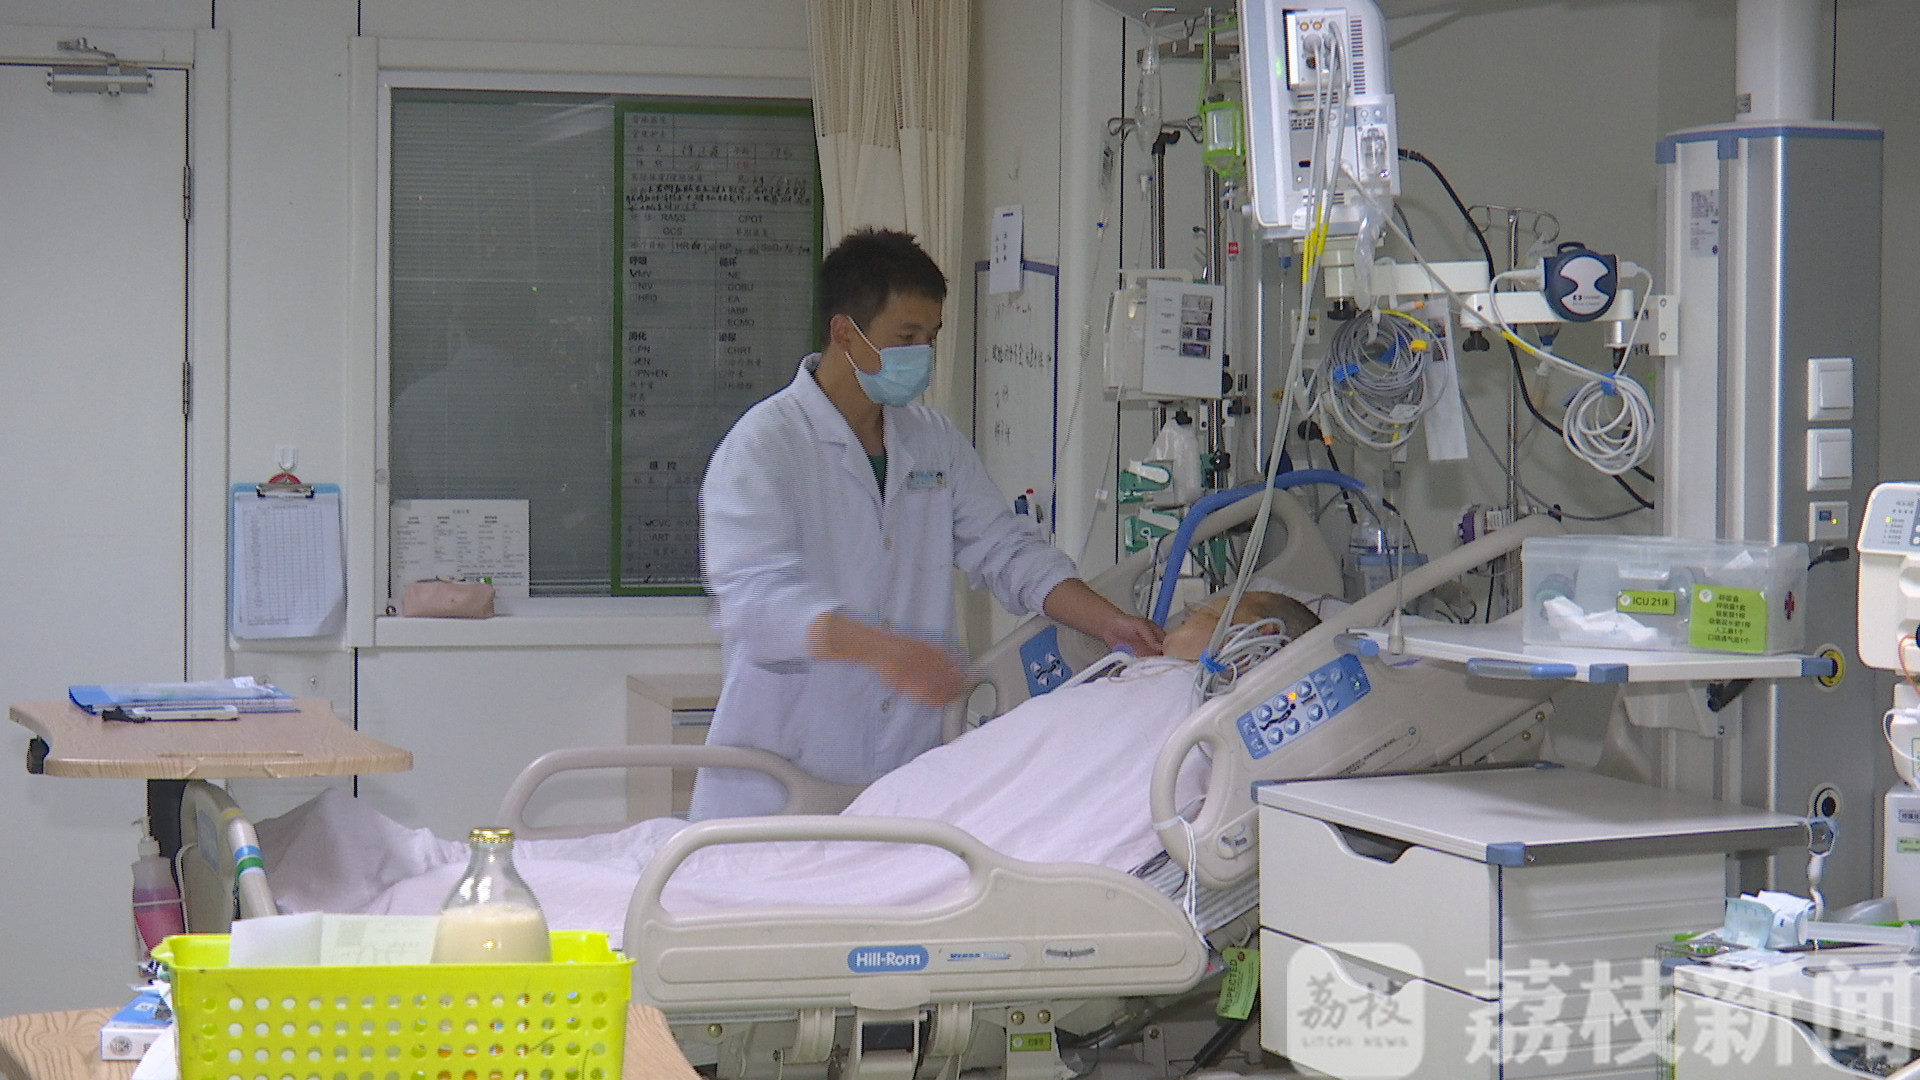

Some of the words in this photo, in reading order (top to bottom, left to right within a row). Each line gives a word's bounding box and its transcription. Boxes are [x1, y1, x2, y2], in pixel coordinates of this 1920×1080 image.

[737, 214, 763, 223] CPOT
[662, 226, 683, 235] GCS
[727, 318, 755, 327] ECMO
[628, 331, 647, 341] 消化
[1632, 596, 1650, 607] ICU
[1651, 597, 1669, 608] 21床
[856, 950, 921, 968] Hill-Rom
